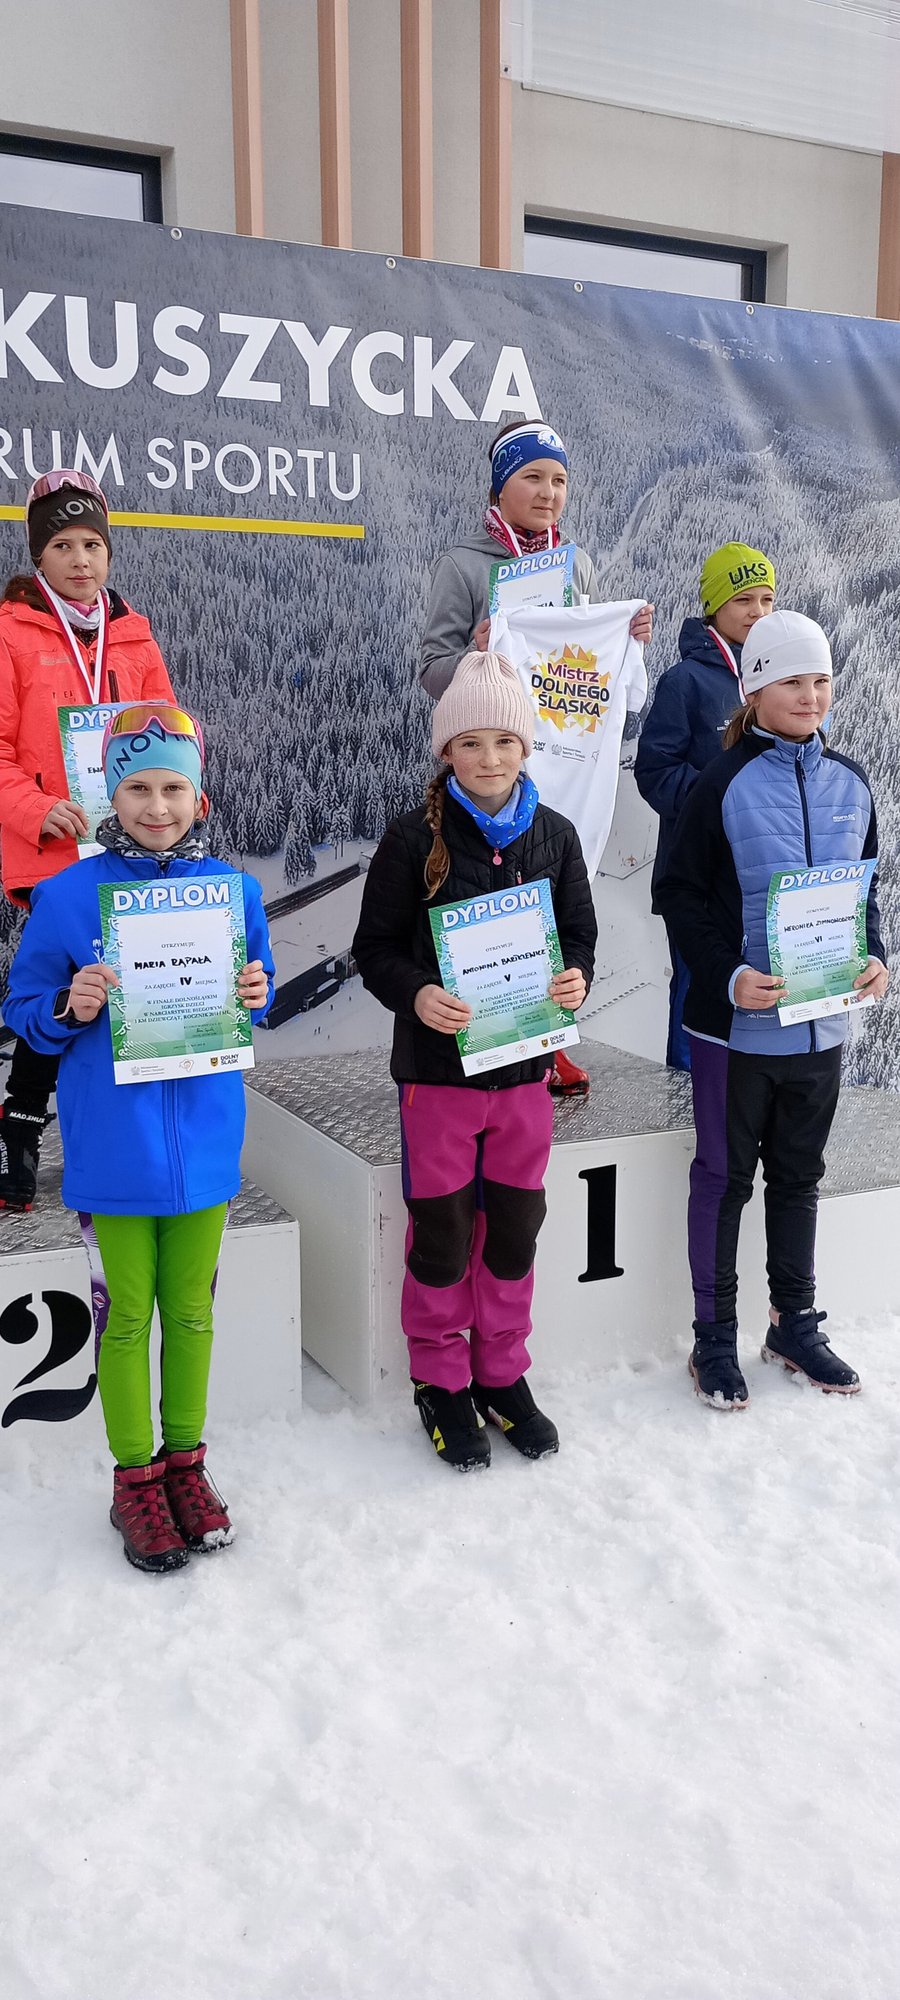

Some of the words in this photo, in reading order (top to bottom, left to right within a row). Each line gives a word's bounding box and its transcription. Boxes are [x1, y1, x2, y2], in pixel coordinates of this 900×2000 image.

[0, 288, 543, 422] KUSZYCKA
[147, 437, 362, 501] SPORTU
[498, 550, 568, 580] DYPLOM
[728, 563, 768, 585] UKS
[547, 662, 600, 683] Mistrz
[531, 674, 610, 702] DOLNEGO
[538, 691, 601, 718] ŚLĄSKA
[779, 864, 867, 891] DYPLOM
[112, 882, 230, 912] DYPLOM
[441, 887, 540, 929] DYPLOM
[134, 960, 166, 970] MARIA
[504, 973, 511, 982] V
[180, 976, 193, 985] IV
[577, 1163, 624, 1283] 1
[0, 1289, 98, 1429] 2
